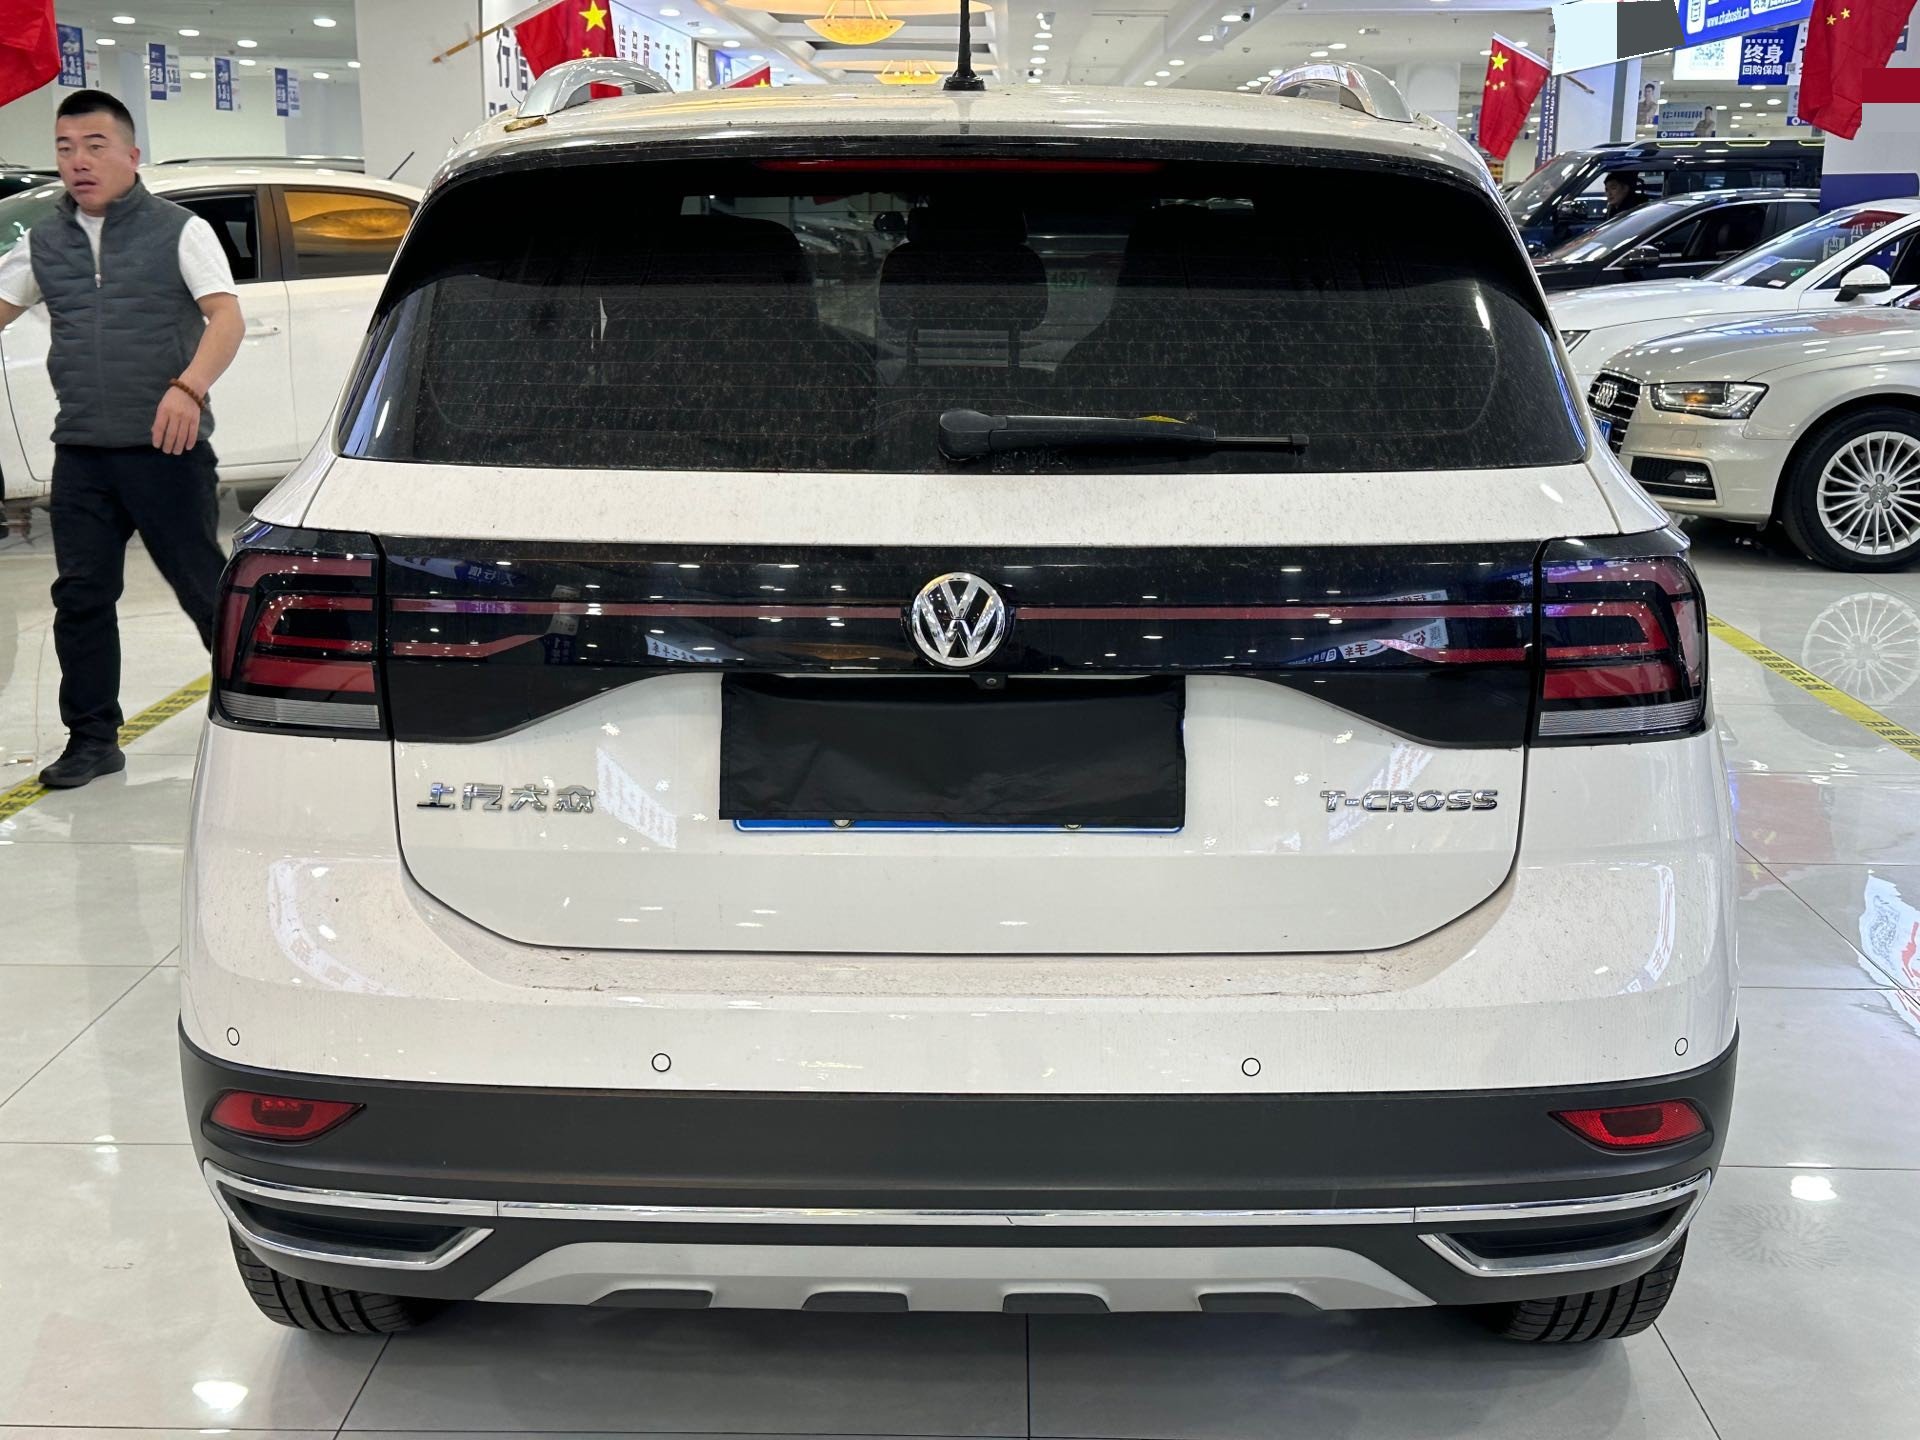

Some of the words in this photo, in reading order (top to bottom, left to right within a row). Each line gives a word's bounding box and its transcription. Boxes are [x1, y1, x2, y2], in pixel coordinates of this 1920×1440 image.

[1743, 44, 1784, 64] 终身
[1742, 65, 1783, 76] 回购保障
[416, 782, 597, 813] 上汽大众
[1320, 789, 1499, 813] T-CROSS
